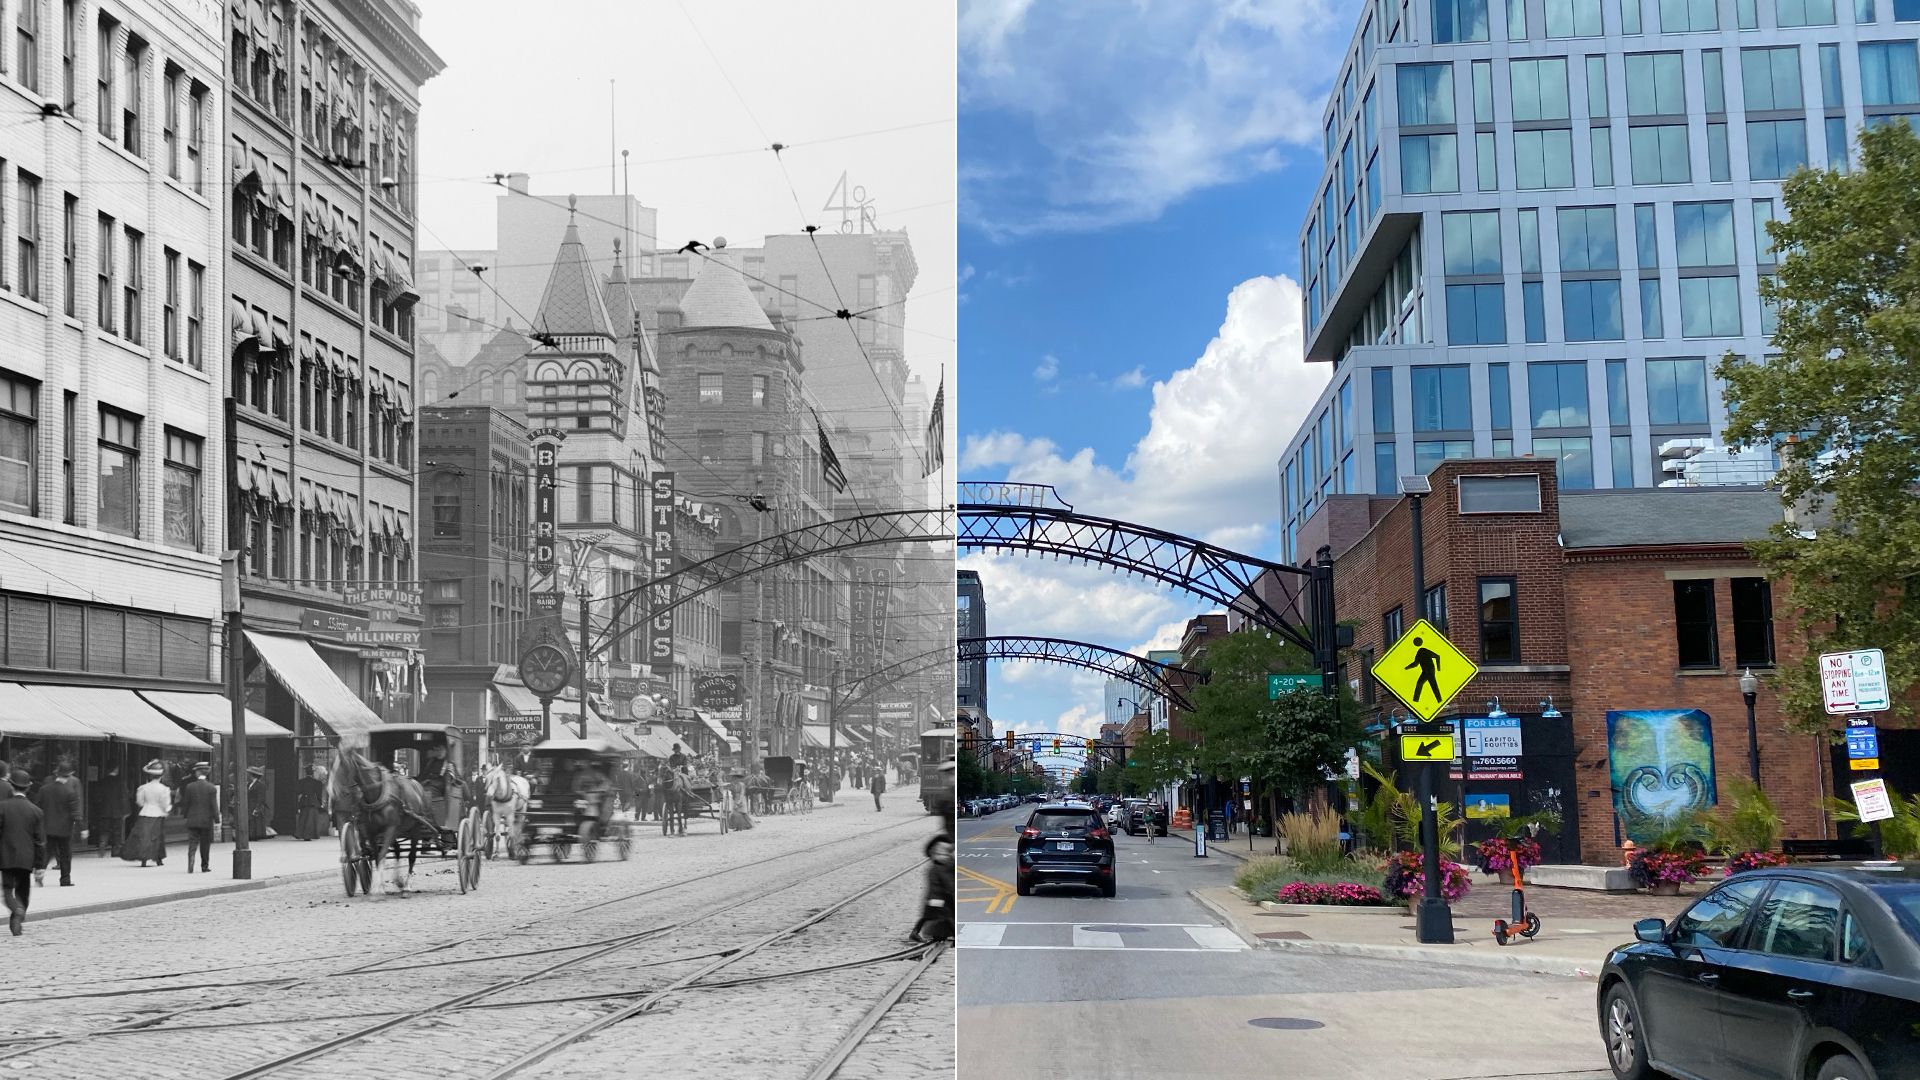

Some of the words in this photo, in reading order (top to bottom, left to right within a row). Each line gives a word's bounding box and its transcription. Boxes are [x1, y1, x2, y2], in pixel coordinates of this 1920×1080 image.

[961, 484, 1044, 506] NORTH
[537, 449, 553, 562] BAIRD
[345, 592, 367, 604] THE
[370, 589, 393, 600] NEW
[395, 590, 421, 605] IDEA
[376, 610, 392, 620] IN
[346, 632, 421, 643] MILLINERY
[1830, 658, 1843, 668] NO
[1825, 669, 1851, 679] STOPPING
[1273, 678, 1294, 686] 4-20
[1832, 680, 1847, 689] ANY
[1832, 689, 1849, 698] TIME
[703, 697, 735, 706] STORE
[1489, 719, 1517, 727] LEASE
